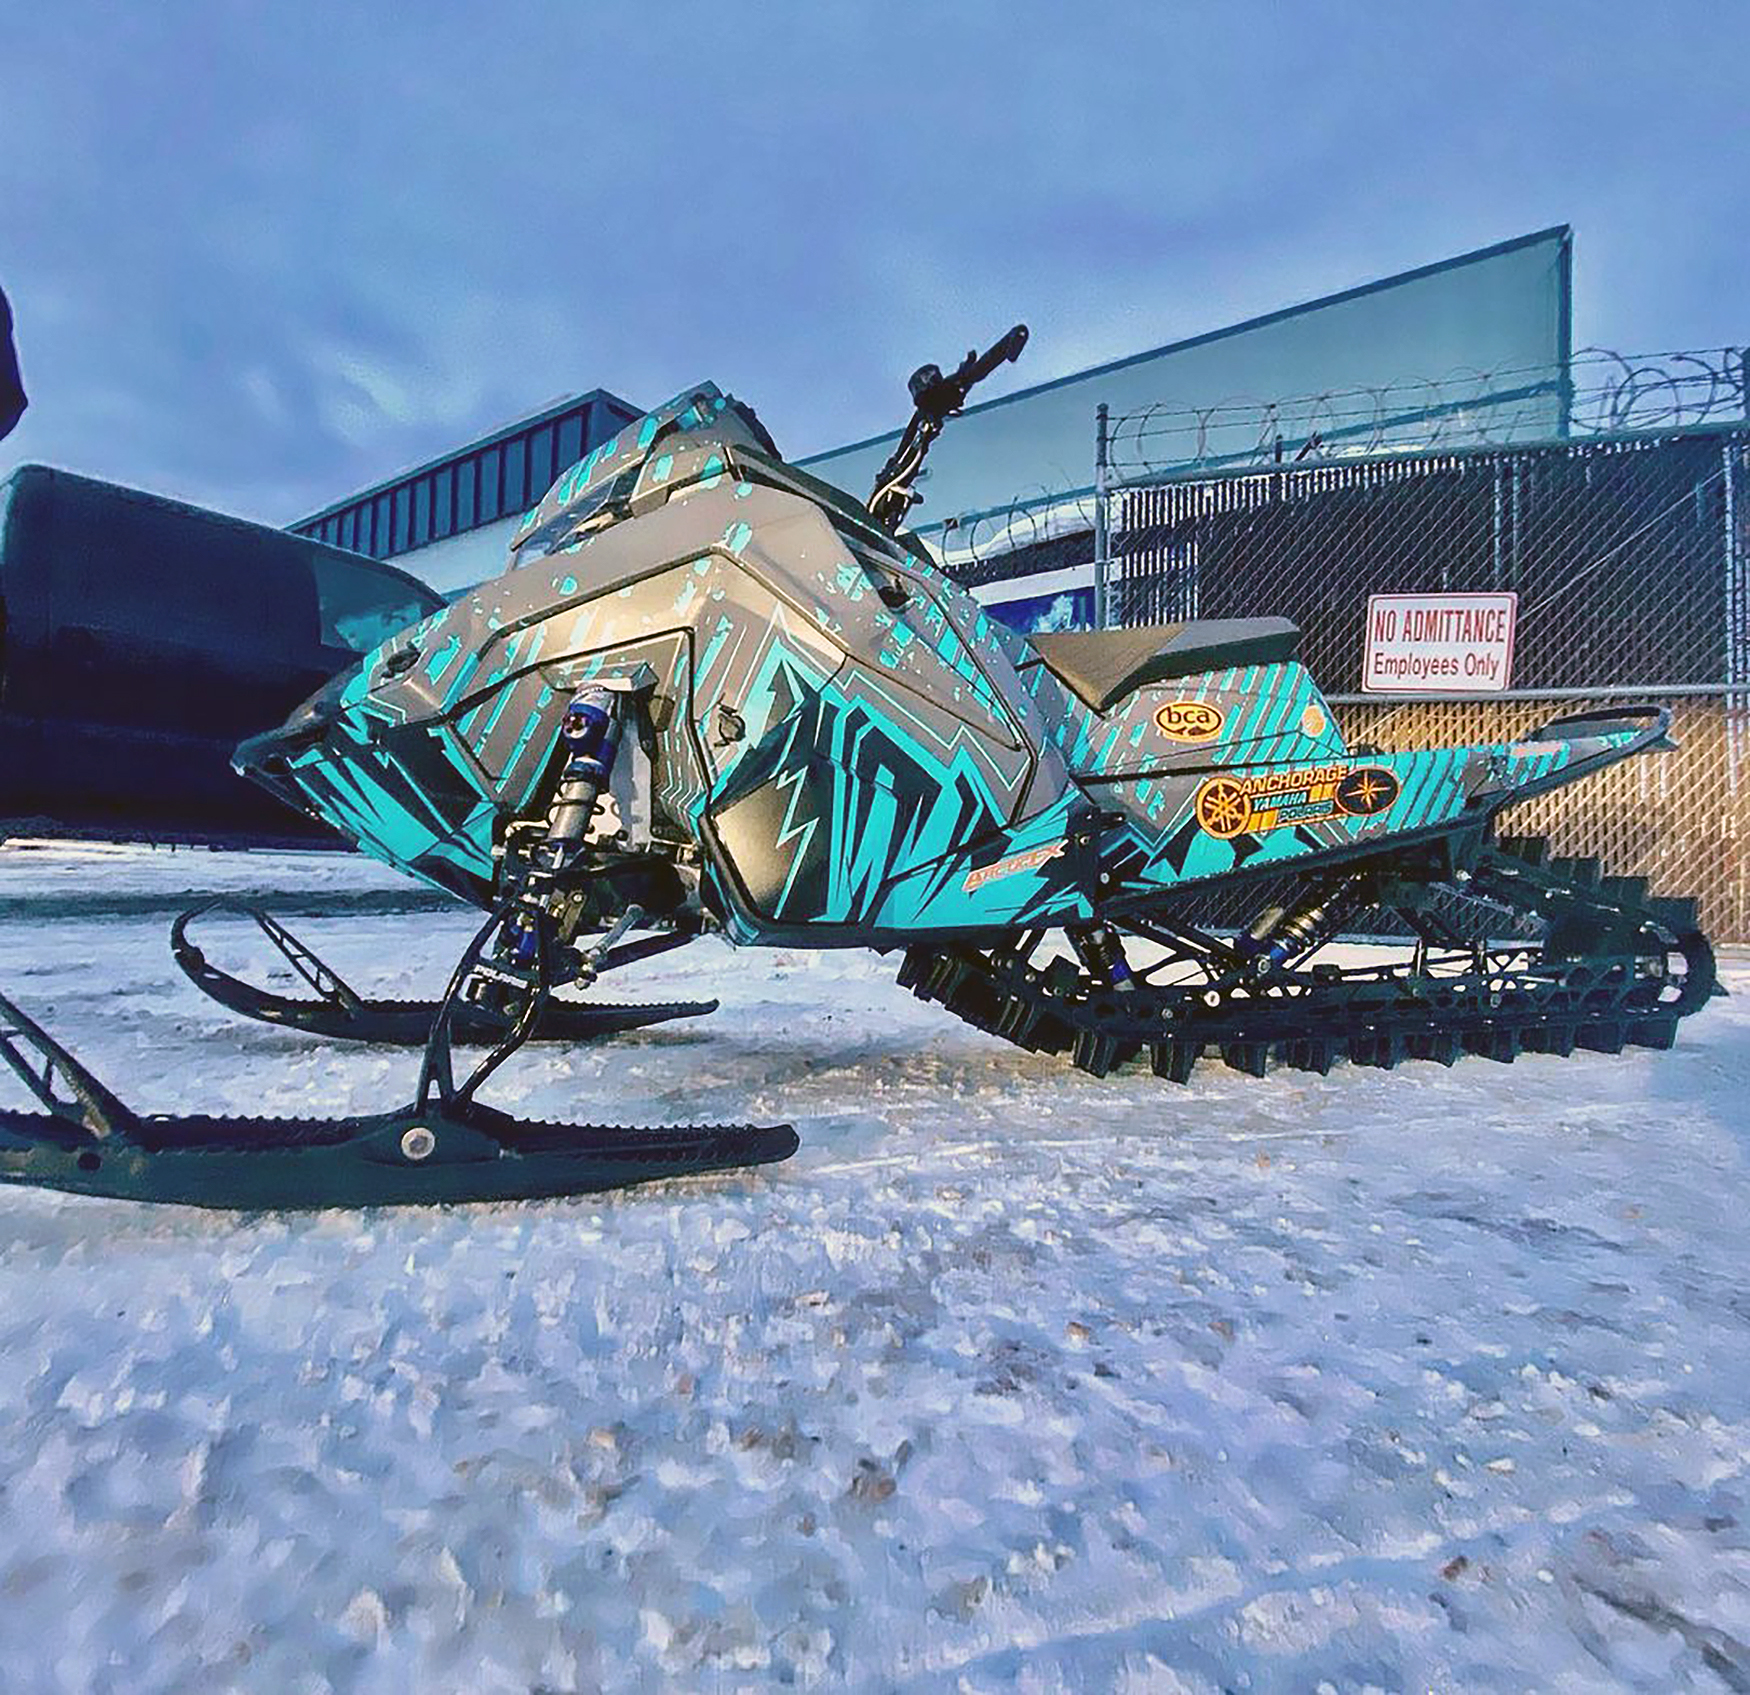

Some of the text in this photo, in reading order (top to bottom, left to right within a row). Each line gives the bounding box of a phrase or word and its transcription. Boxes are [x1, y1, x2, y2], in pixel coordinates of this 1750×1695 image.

[1374, 608, 1506, 643] NO ADMITTANCE
[1374, 652, 1500, 681] Employees Only
[1166, 703, 1211, 725] bca
[1239, 765, 1349, 796] ANCHORAGE
[1253, 791, 1308, 812] YAMAHA
